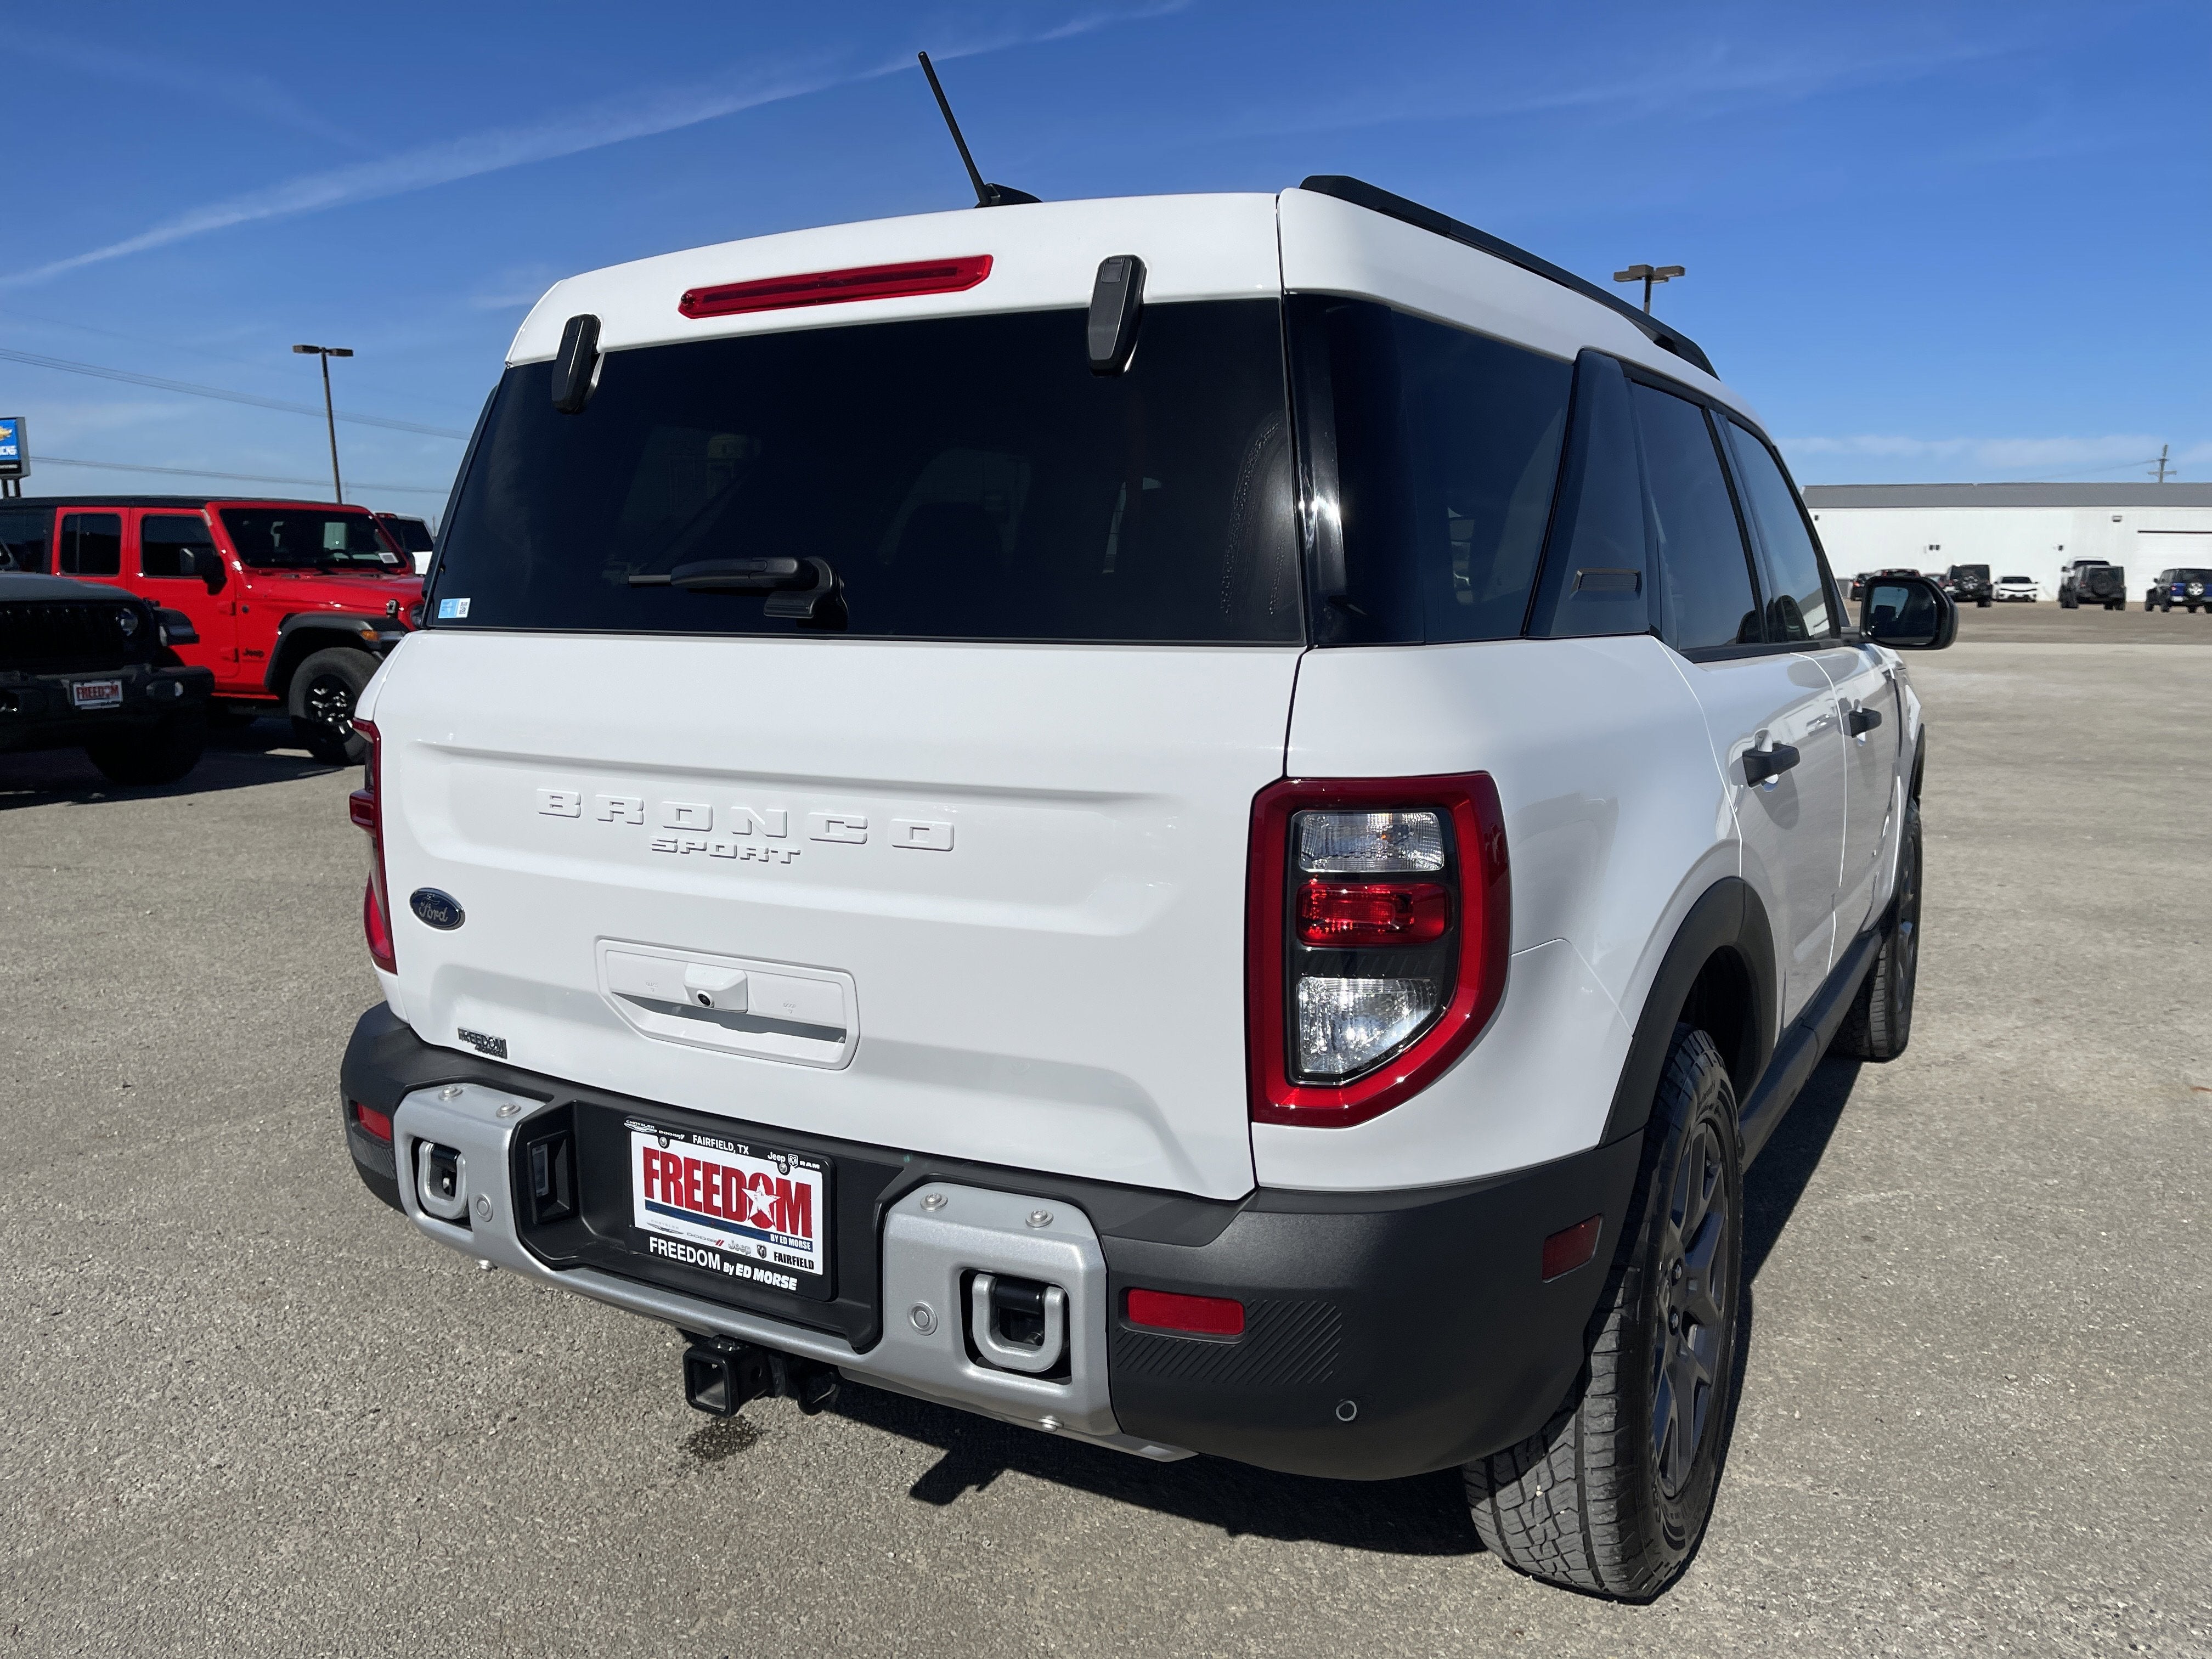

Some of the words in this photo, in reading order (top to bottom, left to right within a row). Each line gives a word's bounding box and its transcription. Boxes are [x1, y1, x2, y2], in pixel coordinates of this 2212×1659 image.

[536, 788, 955, 851] BRONCO
[651, 836, 801, 864] SPORT
[419, 898, 448, 922] Ford
[626, 1120, 655, 1129] CHRYSLER
[692, 1135, 736, 1153] FAIRFIELD,
[737, 1144, 749, 1155] TX
[768, 1152, 786, 1163] Jeep
[800, 1160, 820, 1169] RAM
[642, 1146, 812, 1238] FREEDOM
[728, 1240, 752, 1255] Jeep
[780, 1235, 787, 1245] ED
[789, 1238, 811, 1250] MORSE
[650, 1236, 720, 1271] FREEDOM
[723, 1262, 734, 1276] By
[736, 1263, 752, 1278] ED
[753, 1268, 798, 1291] MORSE
[774, 1251, 814, 1270] FAIRFIELD
